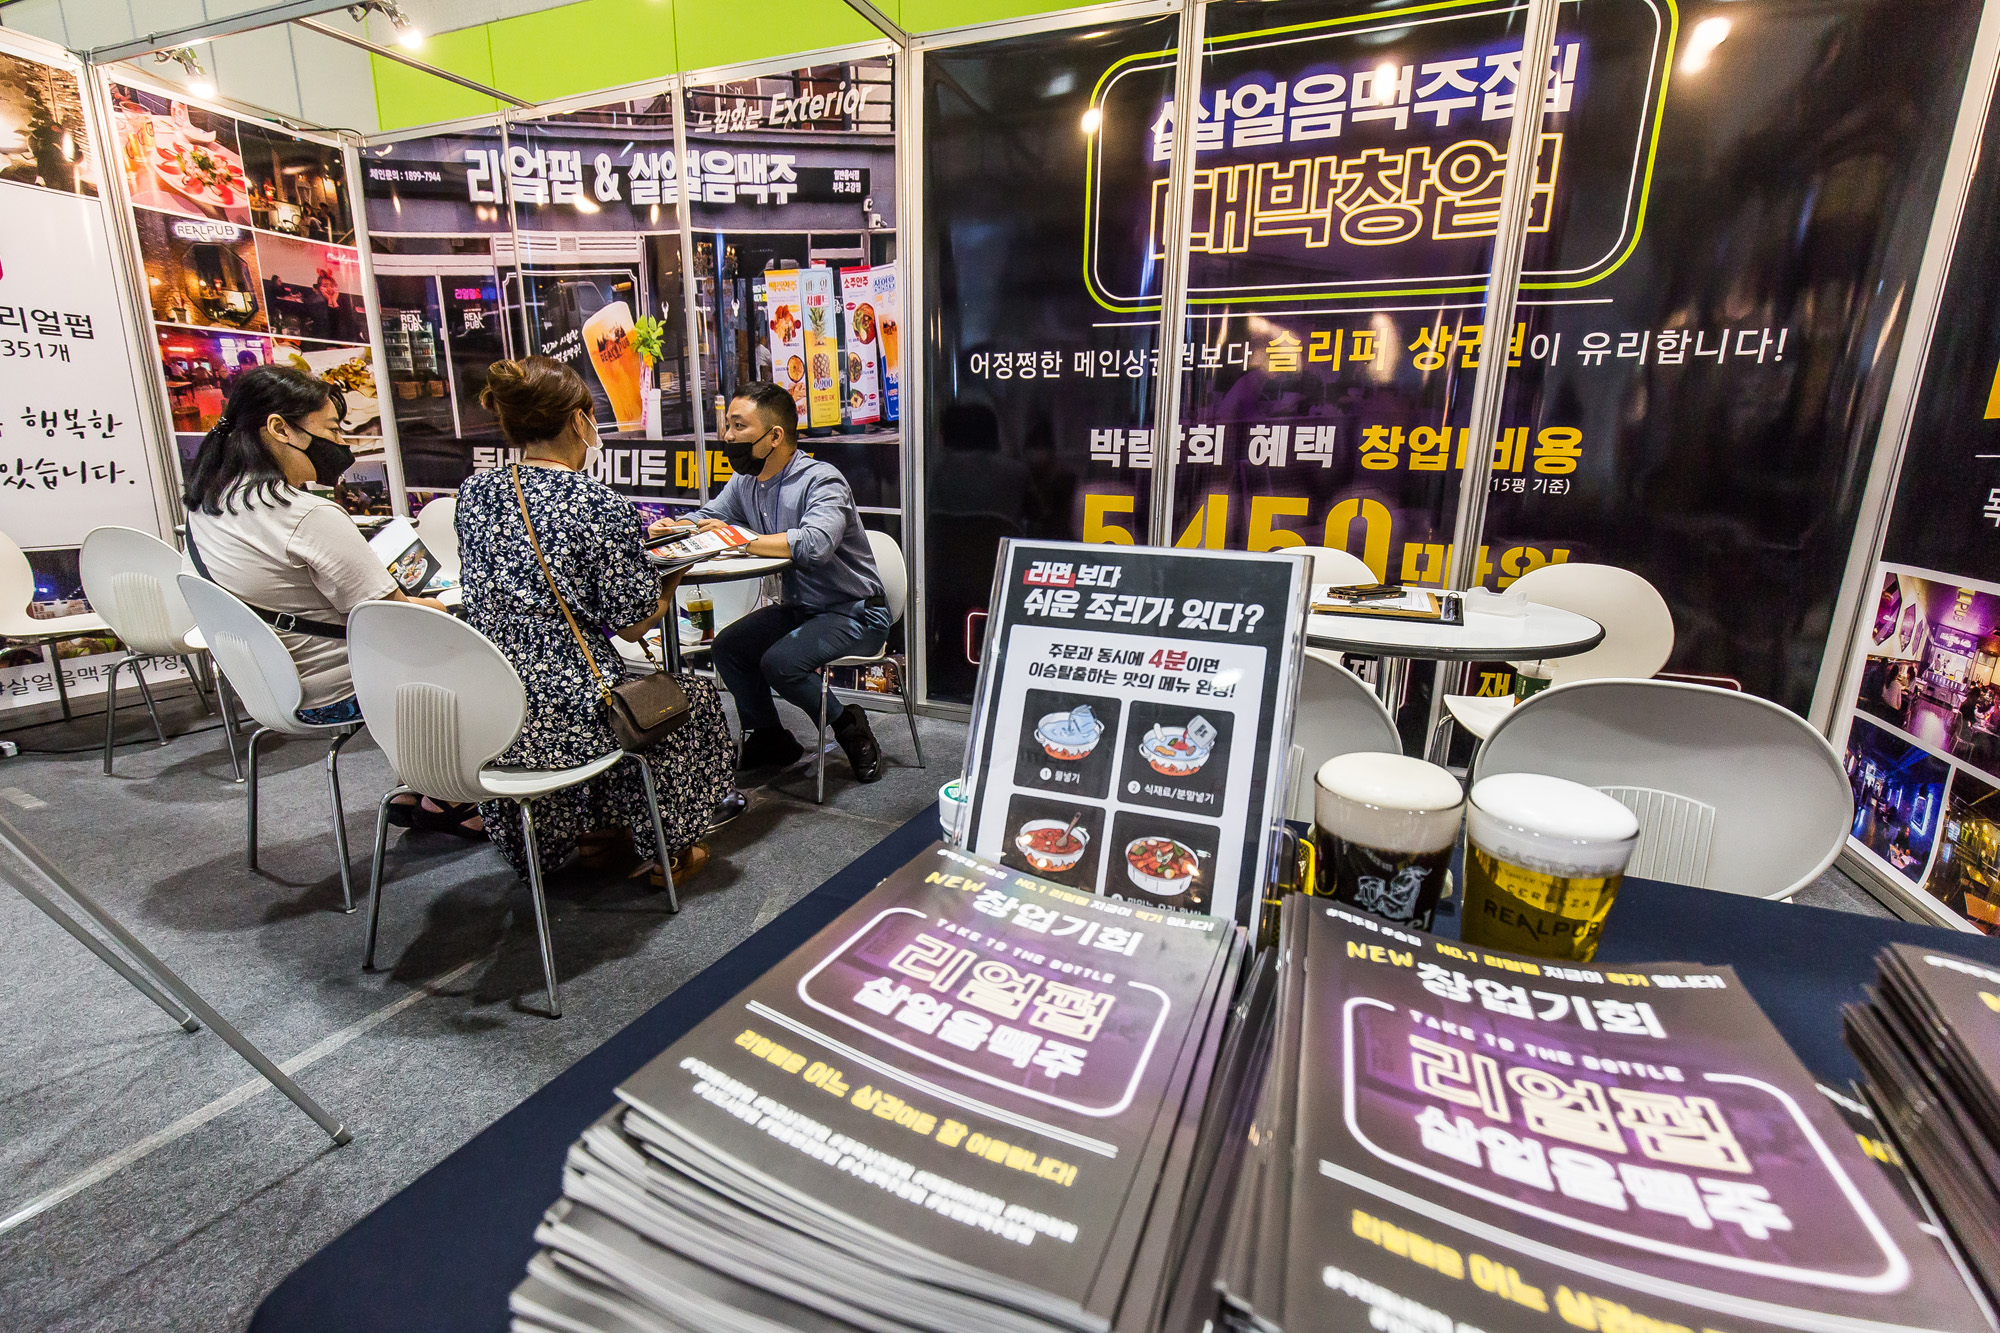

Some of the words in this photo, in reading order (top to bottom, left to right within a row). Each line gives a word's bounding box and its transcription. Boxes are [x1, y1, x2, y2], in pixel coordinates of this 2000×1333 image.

[690, 105, 764, 134] 느낌있는
[769, 81, 873, 127] Exterior
[1149, 43, 1580, 163] 살얼음맥주집
[404, 171, 442, 182] 1899-7944
[465, 146, 584, 206] 리얼펍
[594, 154, 624, 203] &
[630, 150, 799, 206] 살얼음맥주
[1148, 132, 1564, 261] 대박창업
[177, 224, 236, 241] REALPUB
[0, 304, 94, 340] 리얼펍
[400, 314, 423, 324] REAL
[463, 311, 483, 322] REAL
[969, 350, 1064, 381] 어정쩡한
[1073, 339, 1253, 379] 메인상권보다
[1265, 328, 1390, 373] 슬리퍼
[1408, 323, 1560, 371] 상권이
[1577, 326, 1789, 367] 유리합니다!
[813, 378, 833, 391] 6,900
[20, 406, 123, 440] 행복한
[1090, 424, 1226, 469] 박람회
[1247, 424, 1337, 470] 혜택
[1359, 425, 1584, 475] 창업비용
[1532, 478, 1572, 496] 기준)
[1027, 560, 1071, 586] 라면
[1075, 565, 1122, 589] 보다
[1023, 588, 1080, 619] 쉬운
[1083, 592, 1175, 628] 조리가
[1178, 597, 1265, 634] 있다?
[127, 653, 181, 677] #가성
[1028, 661, 1118, 686] 이승탈출하는
[1122, 671, 1155, 690] 맛의
[1158, 675, 1191, 694] 메뉴
[1048, 642, 1094, 662] 주문과
[1097, 647, 1145, 668] 동시에
[1148, 648, 1221, 675] 4분이면
[925, 871, 987, 893] NEW
[972, 888, 1145, 957] 창업기회
[1483, 898, 1600, 943] REALPUB
[936, 917, 983, 942] TAKE
[986, 937, 1008, 952] TO
[1012, 946, 1046, 965] THE
[1049, 958, 1117, 985] BOTTLE
[1346, 940, 1414, 967] NEW
[1435, 942, 1478, 963] NO.1
[887, 932, 1118, 1042] 리얼펍
[1416, 961, 1668, 1039] 창업기회
[853, 976, 1089, 1079] 살얼음맥주
[1409, 1009, 1474, 1041] TAKE
[1484, 1033, 1516, 1053] TO
[1523, 1043, 1574, 1066] THE
[1580, 1055, 1685, 1082] BOTTLE
[803, 1061, 850, 1098] 어느
[1408, 1033, 1754, 1175] 리얼펍
[1414, 1105, 1794, 1241] 살얼음맥주
